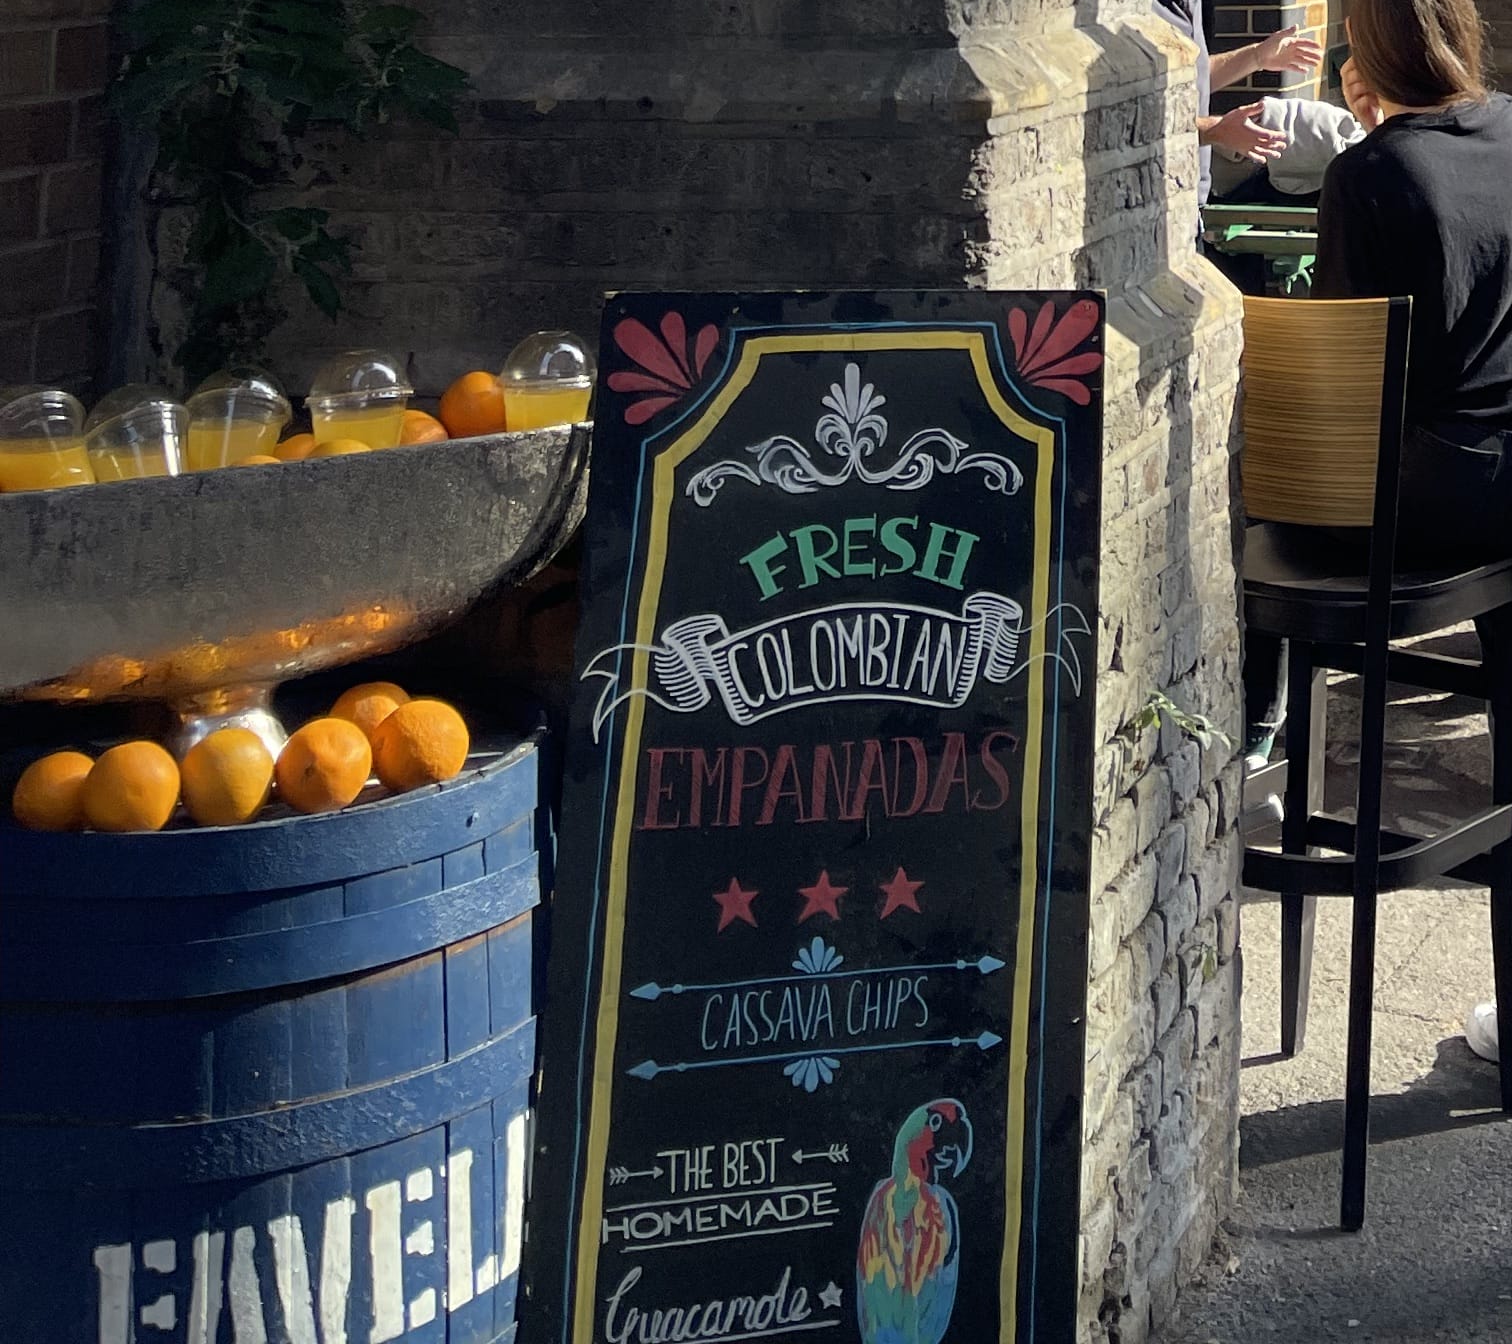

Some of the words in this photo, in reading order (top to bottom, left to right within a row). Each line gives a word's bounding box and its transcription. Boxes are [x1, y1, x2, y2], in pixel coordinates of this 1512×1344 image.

[739, 512, 980, 602] FRESH
[725, 614, 968, 709] COLOMBIAN
[636, 731, 1020, 831] EMPANADAS
[701, 983, 834, 1050] CASSAVA
[847, 975, 929, 1036] CHIPS
[656, 1145, 716, 1194] THE
[722, 1137, 785, 1189] BEST
[602, 1187, 840, 1245] HOMEMADE
[604, 1265, 812, 1344] Guacamole
